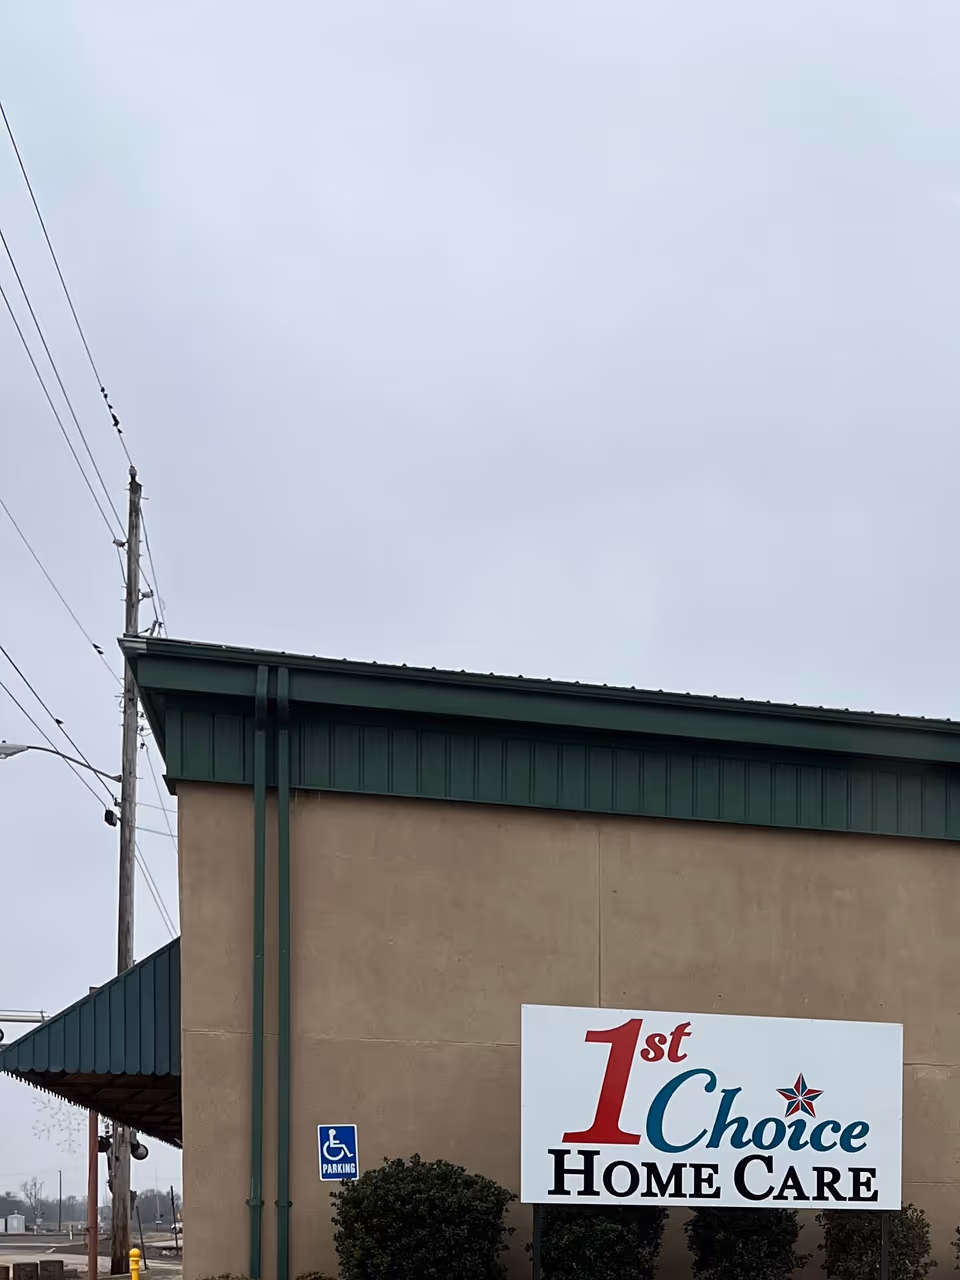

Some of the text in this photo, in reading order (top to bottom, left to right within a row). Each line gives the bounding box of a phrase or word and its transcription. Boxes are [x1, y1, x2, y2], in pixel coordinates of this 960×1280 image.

[561, 1018, 692, 1145] 1st
[645, 1068, 870, 1153] Choice
[322, 1163, 356, 1174] PARKING
[547, 1149, 879, 1202] HOME CARE
